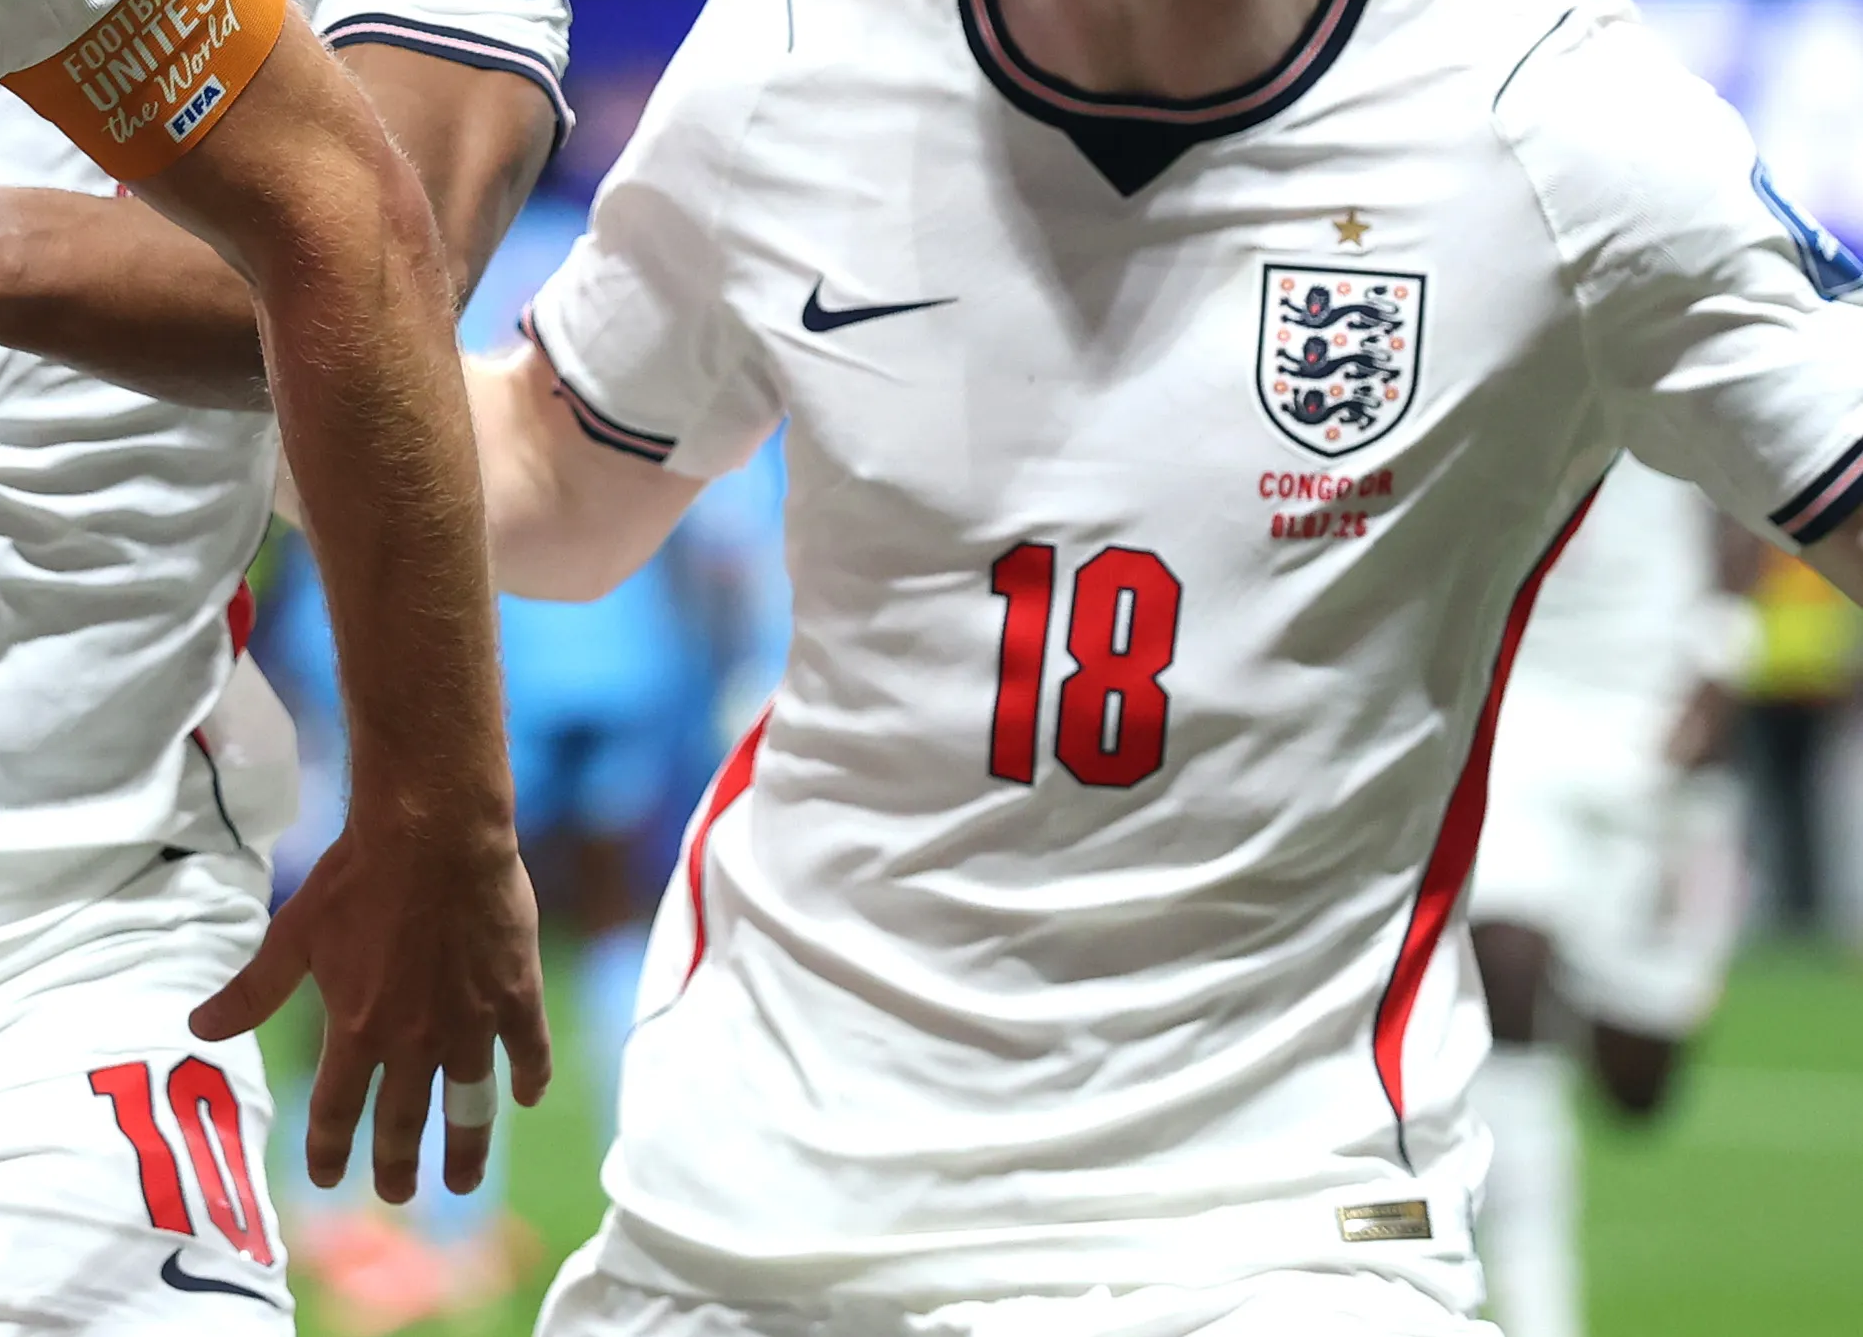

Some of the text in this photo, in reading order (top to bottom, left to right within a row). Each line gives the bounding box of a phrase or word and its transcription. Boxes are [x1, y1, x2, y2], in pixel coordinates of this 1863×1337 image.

[102, 100, 159, 144] the
[172, 85, 222, 136] FIFA
[1259, 469, 1393, 501] CONGO DR
[1271, 511, 1368, 538] 01.07.26
[990, 542, 1181, 787] 18
[87, 1055, 275, 1268] 10
